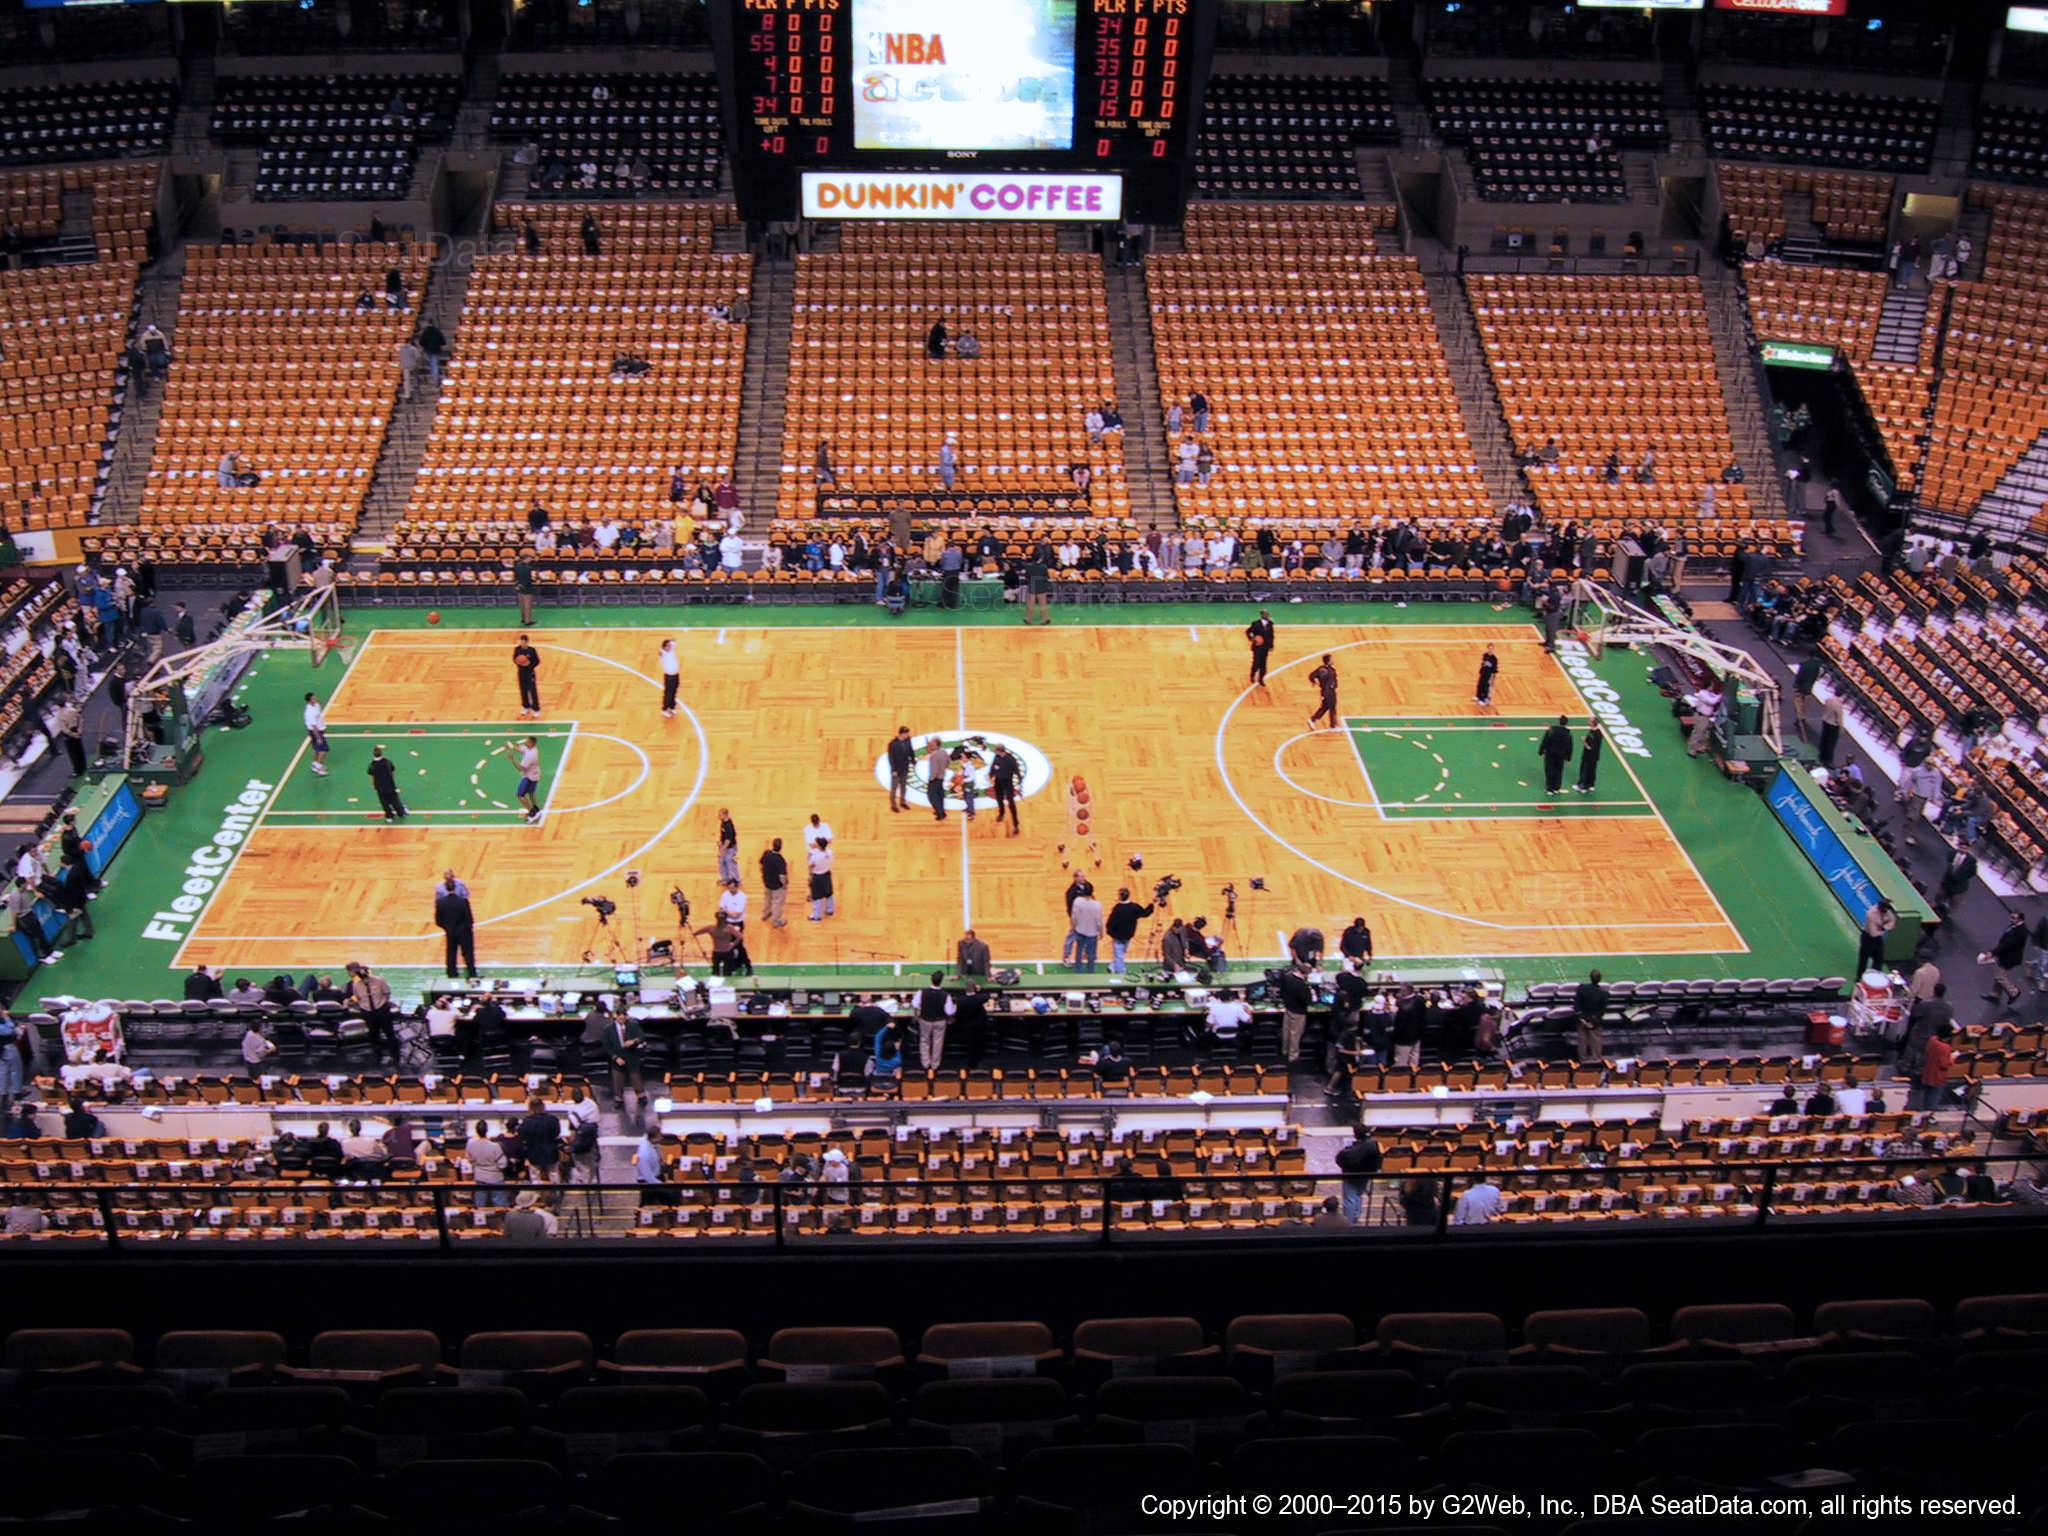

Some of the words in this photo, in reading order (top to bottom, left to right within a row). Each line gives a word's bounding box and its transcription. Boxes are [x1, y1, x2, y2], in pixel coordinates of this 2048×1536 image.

[1094, 0, 1126, 13] PLR
[1135, 0, 1146, 13] F
[1153, 0, 1187, 14] PTS
[762, 13, 774, 31] 8
[788, 13, 800, 32] 0
[819, 14, 832, 32] 0
[1096, 17, 1122, 35] 34
[1134, 17, 1148, 36] 0
[1165, 18, 1179, 36] 0
[751, 34, 775, 52] 55
[788, 34, 800, 52] 0
[820, 35, 832, 53] 0
[885, 32, 947, 66] NBA
[1096, 38, 1121, 56] 35
[1133, 38, 1147, 57] 0
[1164, 39, 1178, 57] 0
[764, 55, 777, 72] 4
[789, 55, 801, 73] 0
[820, 55, 833, 74] 0
[1094, 58, 1120, 76] 33
[1132, 59, 1146, 77] 0
[1163, 59, 1177, 78] 0
[766, 75, 777, 93] 7
[789, 75, 802, 94] 0
[821, 75, 833, 94] 0
[1100, 79, 1119, 97] 13
[1130, 79, 1144, 97] 0
[1161, 80, 1175, 98] 0
[753, 96, 777, 114] 34
[790, 96, 802, 114] 0
[821, 96, 833, 114] 0
[1099, 99, 1118, 117] 15
[1130, 99, 1144, 118] 0
[1160, 100, 1174, 118] 0
[816, 136, 829, 154] 0
[1097, 138, 1110, 157] 0
[1152, 139, 1166, 157] 0
[946, 151, 979, 159] SONY
[817, 182, 965, 210] DUNKIN'
[969, 183, 1103, 212] COFFEE
[1554, 638, 1653, 758] FleetCenter
[141, 778, 274, 942] FleetCenter
